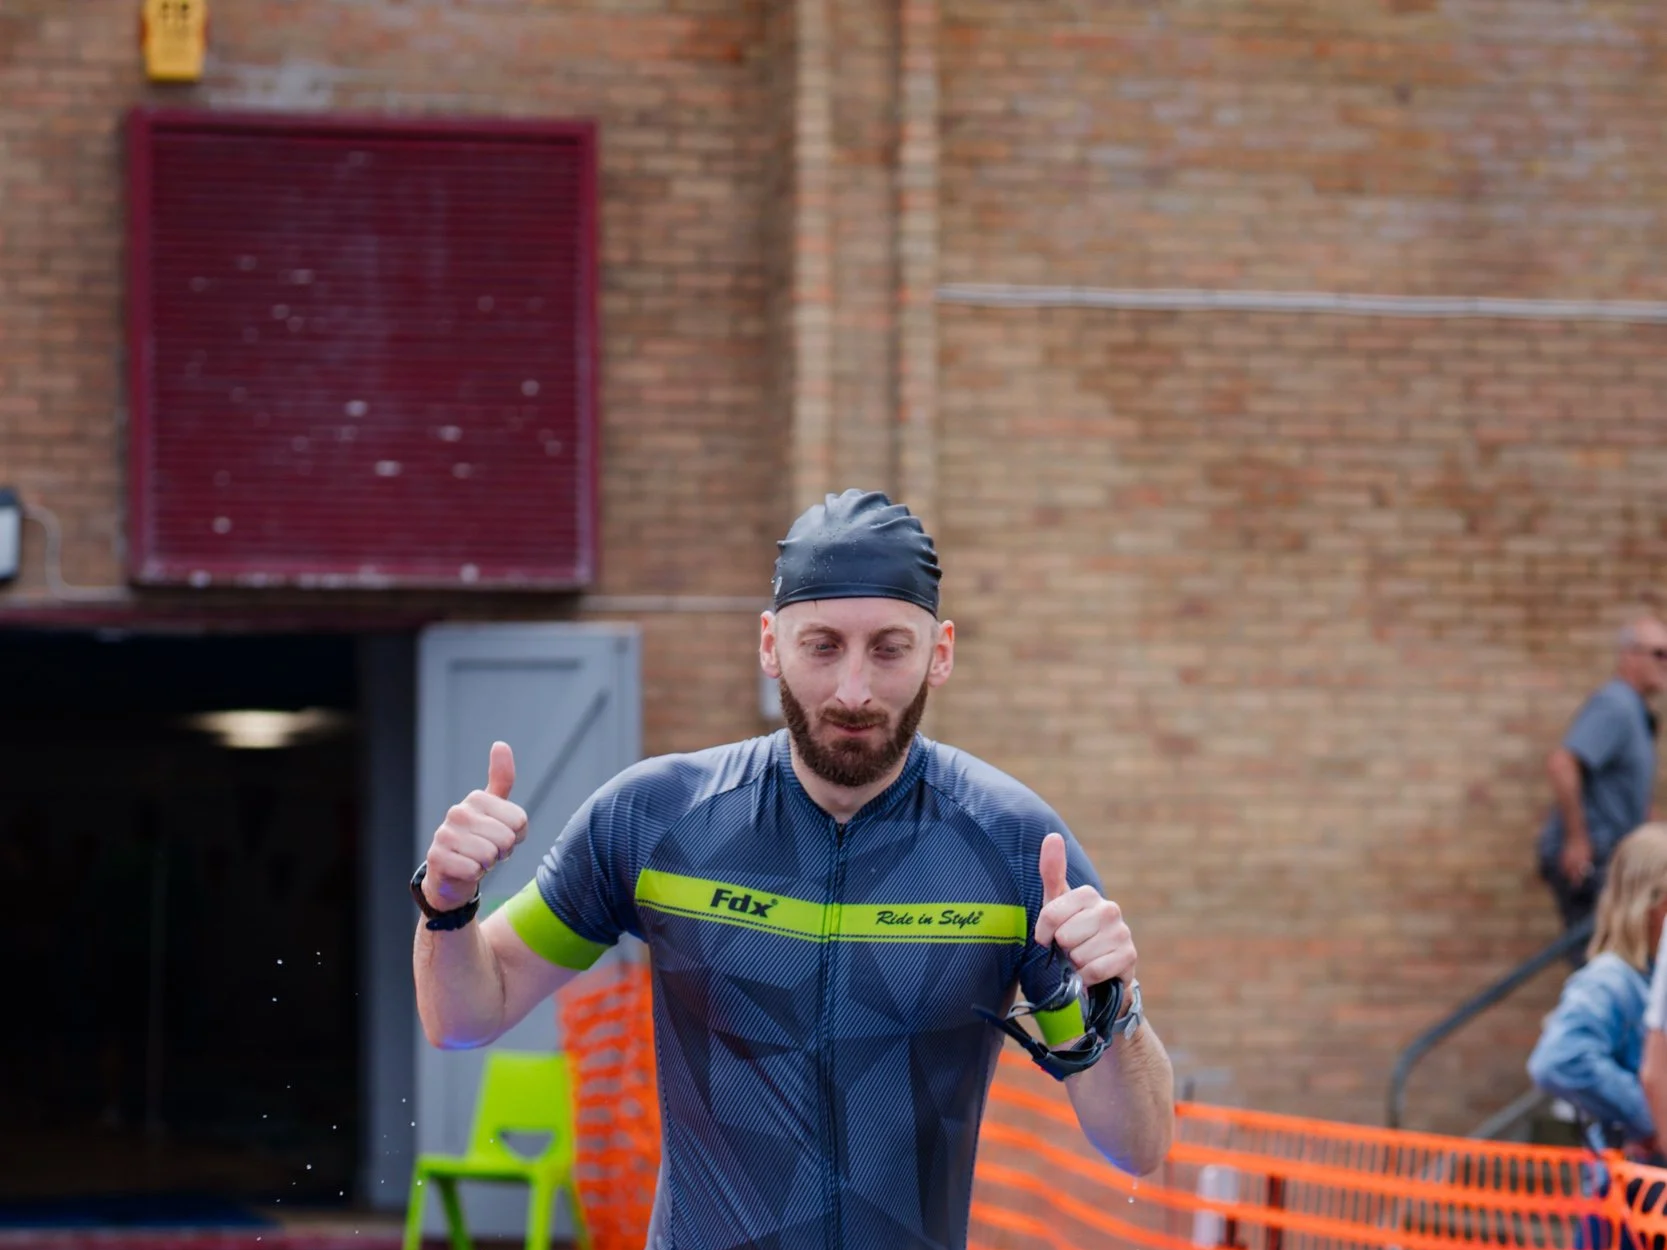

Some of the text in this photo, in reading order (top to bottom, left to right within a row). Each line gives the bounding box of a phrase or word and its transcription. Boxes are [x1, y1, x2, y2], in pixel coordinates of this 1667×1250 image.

[710, 888, 773, 918] Fdx
[876, 910, 981, 929] Ride in Style
